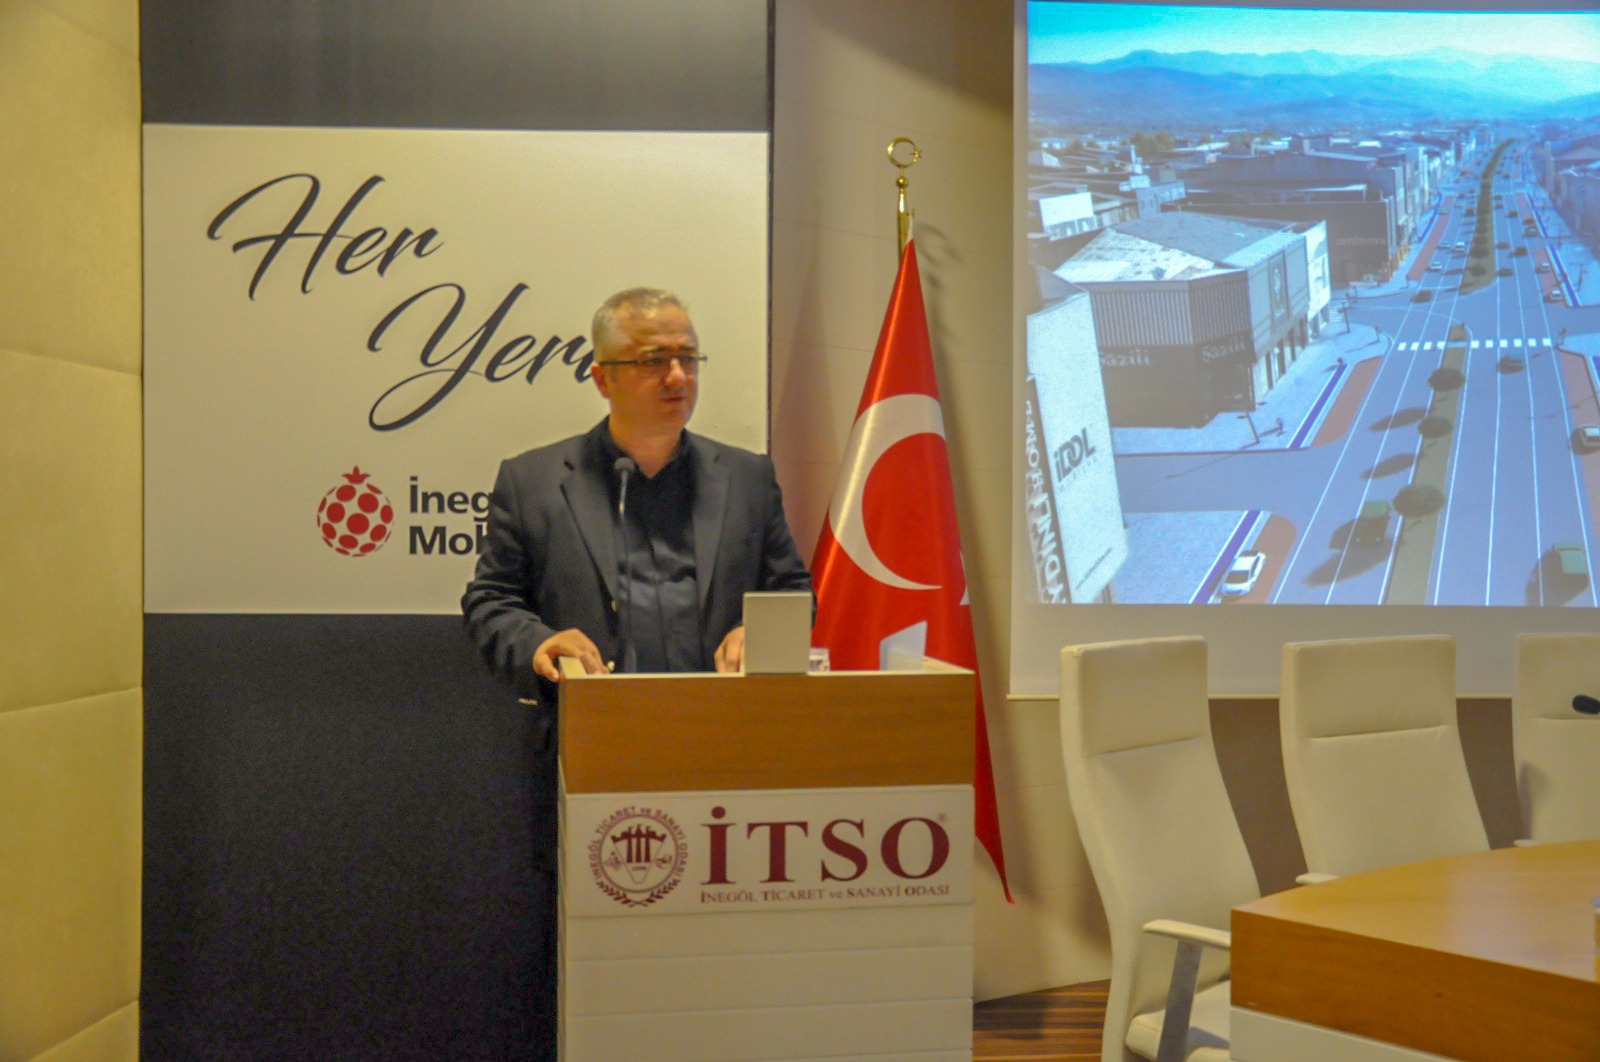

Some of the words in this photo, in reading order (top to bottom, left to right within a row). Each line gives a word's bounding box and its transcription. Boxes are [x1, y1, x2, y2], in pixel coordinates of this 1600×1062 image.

[207, 173, 445, 300] Her
[700, 806, 950, 886] İTSO
[762, 888, 825, 901] TİCARET
[828, 889, 843, 899] ve
[846, 885, 901, 898] SANAYİ
[904, 885, 950, 896] ODASI
